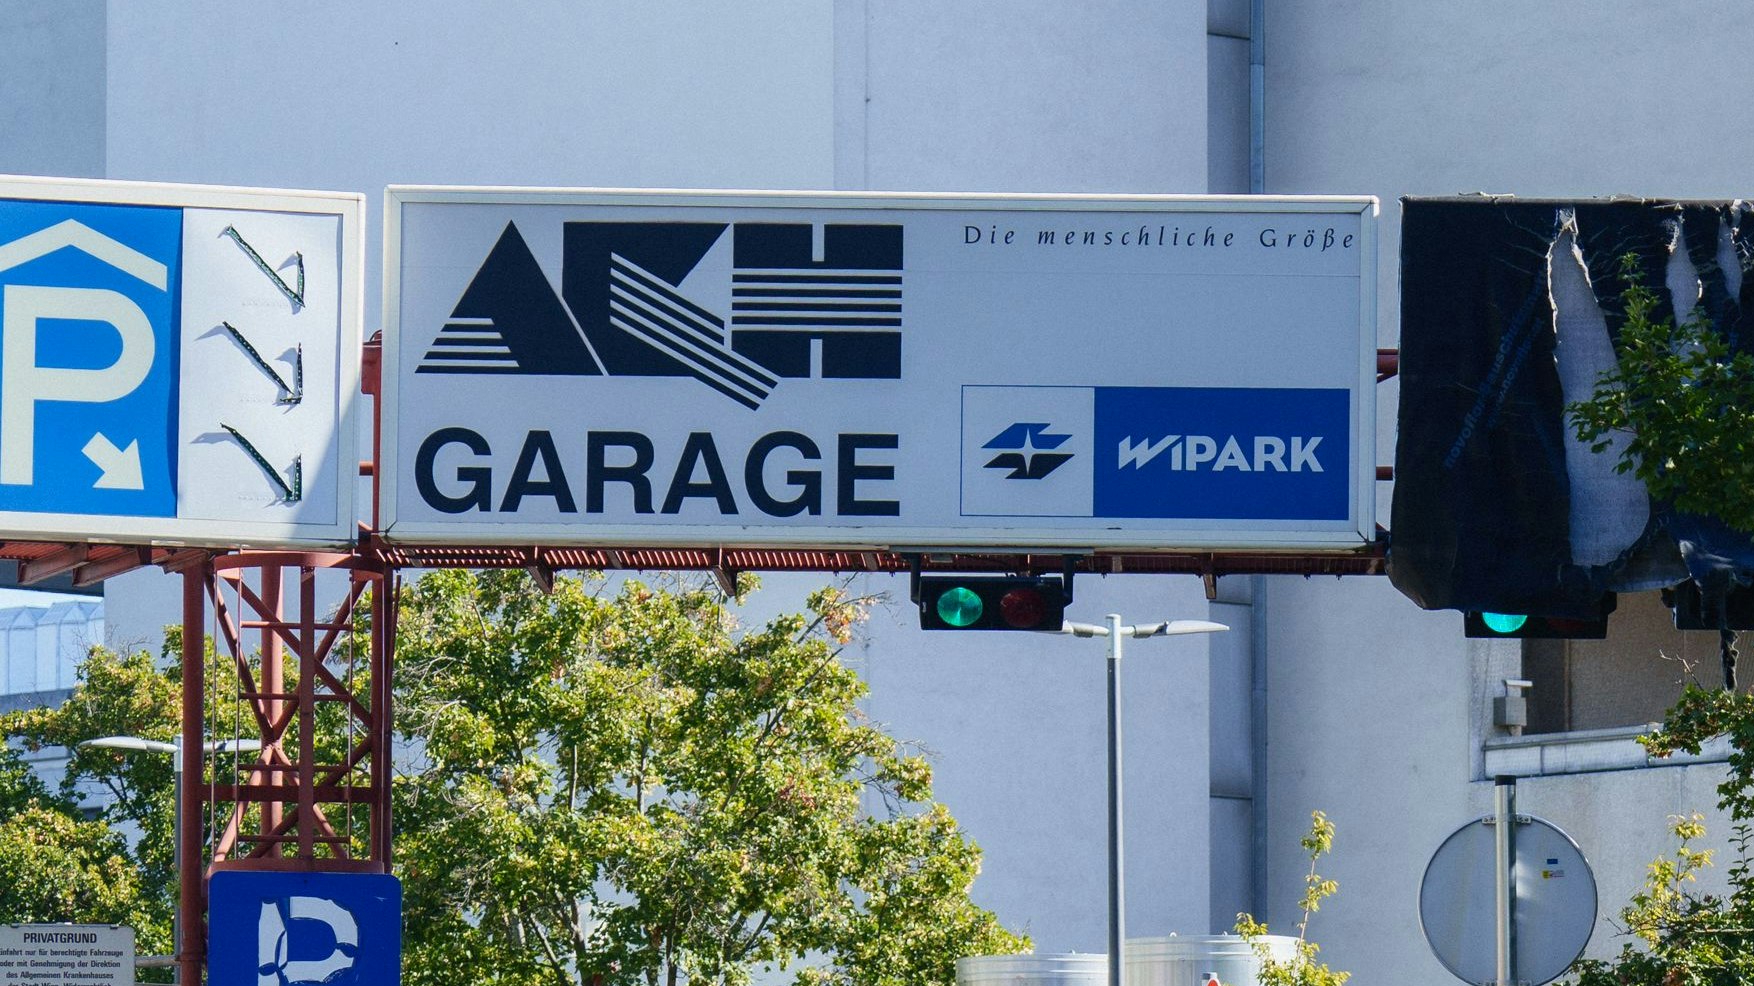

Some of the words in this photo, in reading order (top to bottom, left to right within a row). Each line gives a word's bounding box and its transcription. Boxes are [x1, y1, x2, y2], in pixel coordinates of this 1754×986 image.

[964, 225, 1015, 245] Die
[1037, 225, 1234, 247] menschliche
[1259, 226, 1354, 252] Größe
[415, 219, 904, 412] AKH
[1, 284, 157, 487] P
[414, 426, 901, 518] GARAGE
[23, 932, 98, 944] PRIVATGRUND
[38, 948, 49, 956] für
[49, 948, 88, 958] berechtigte
[89, 948, 124, 958] Fahrzeuge
[16, 959, 28, 968] mit
[29, 959, 76, 970] Genehmigung
[76, 959, 89, 968] der
[90, 959, 121, 968] Direktion
[5, 970, 19, 979] des
[19, 970, 62, 981] Allgemeinen
[63, 970, 114, 980] Krankenhauses
